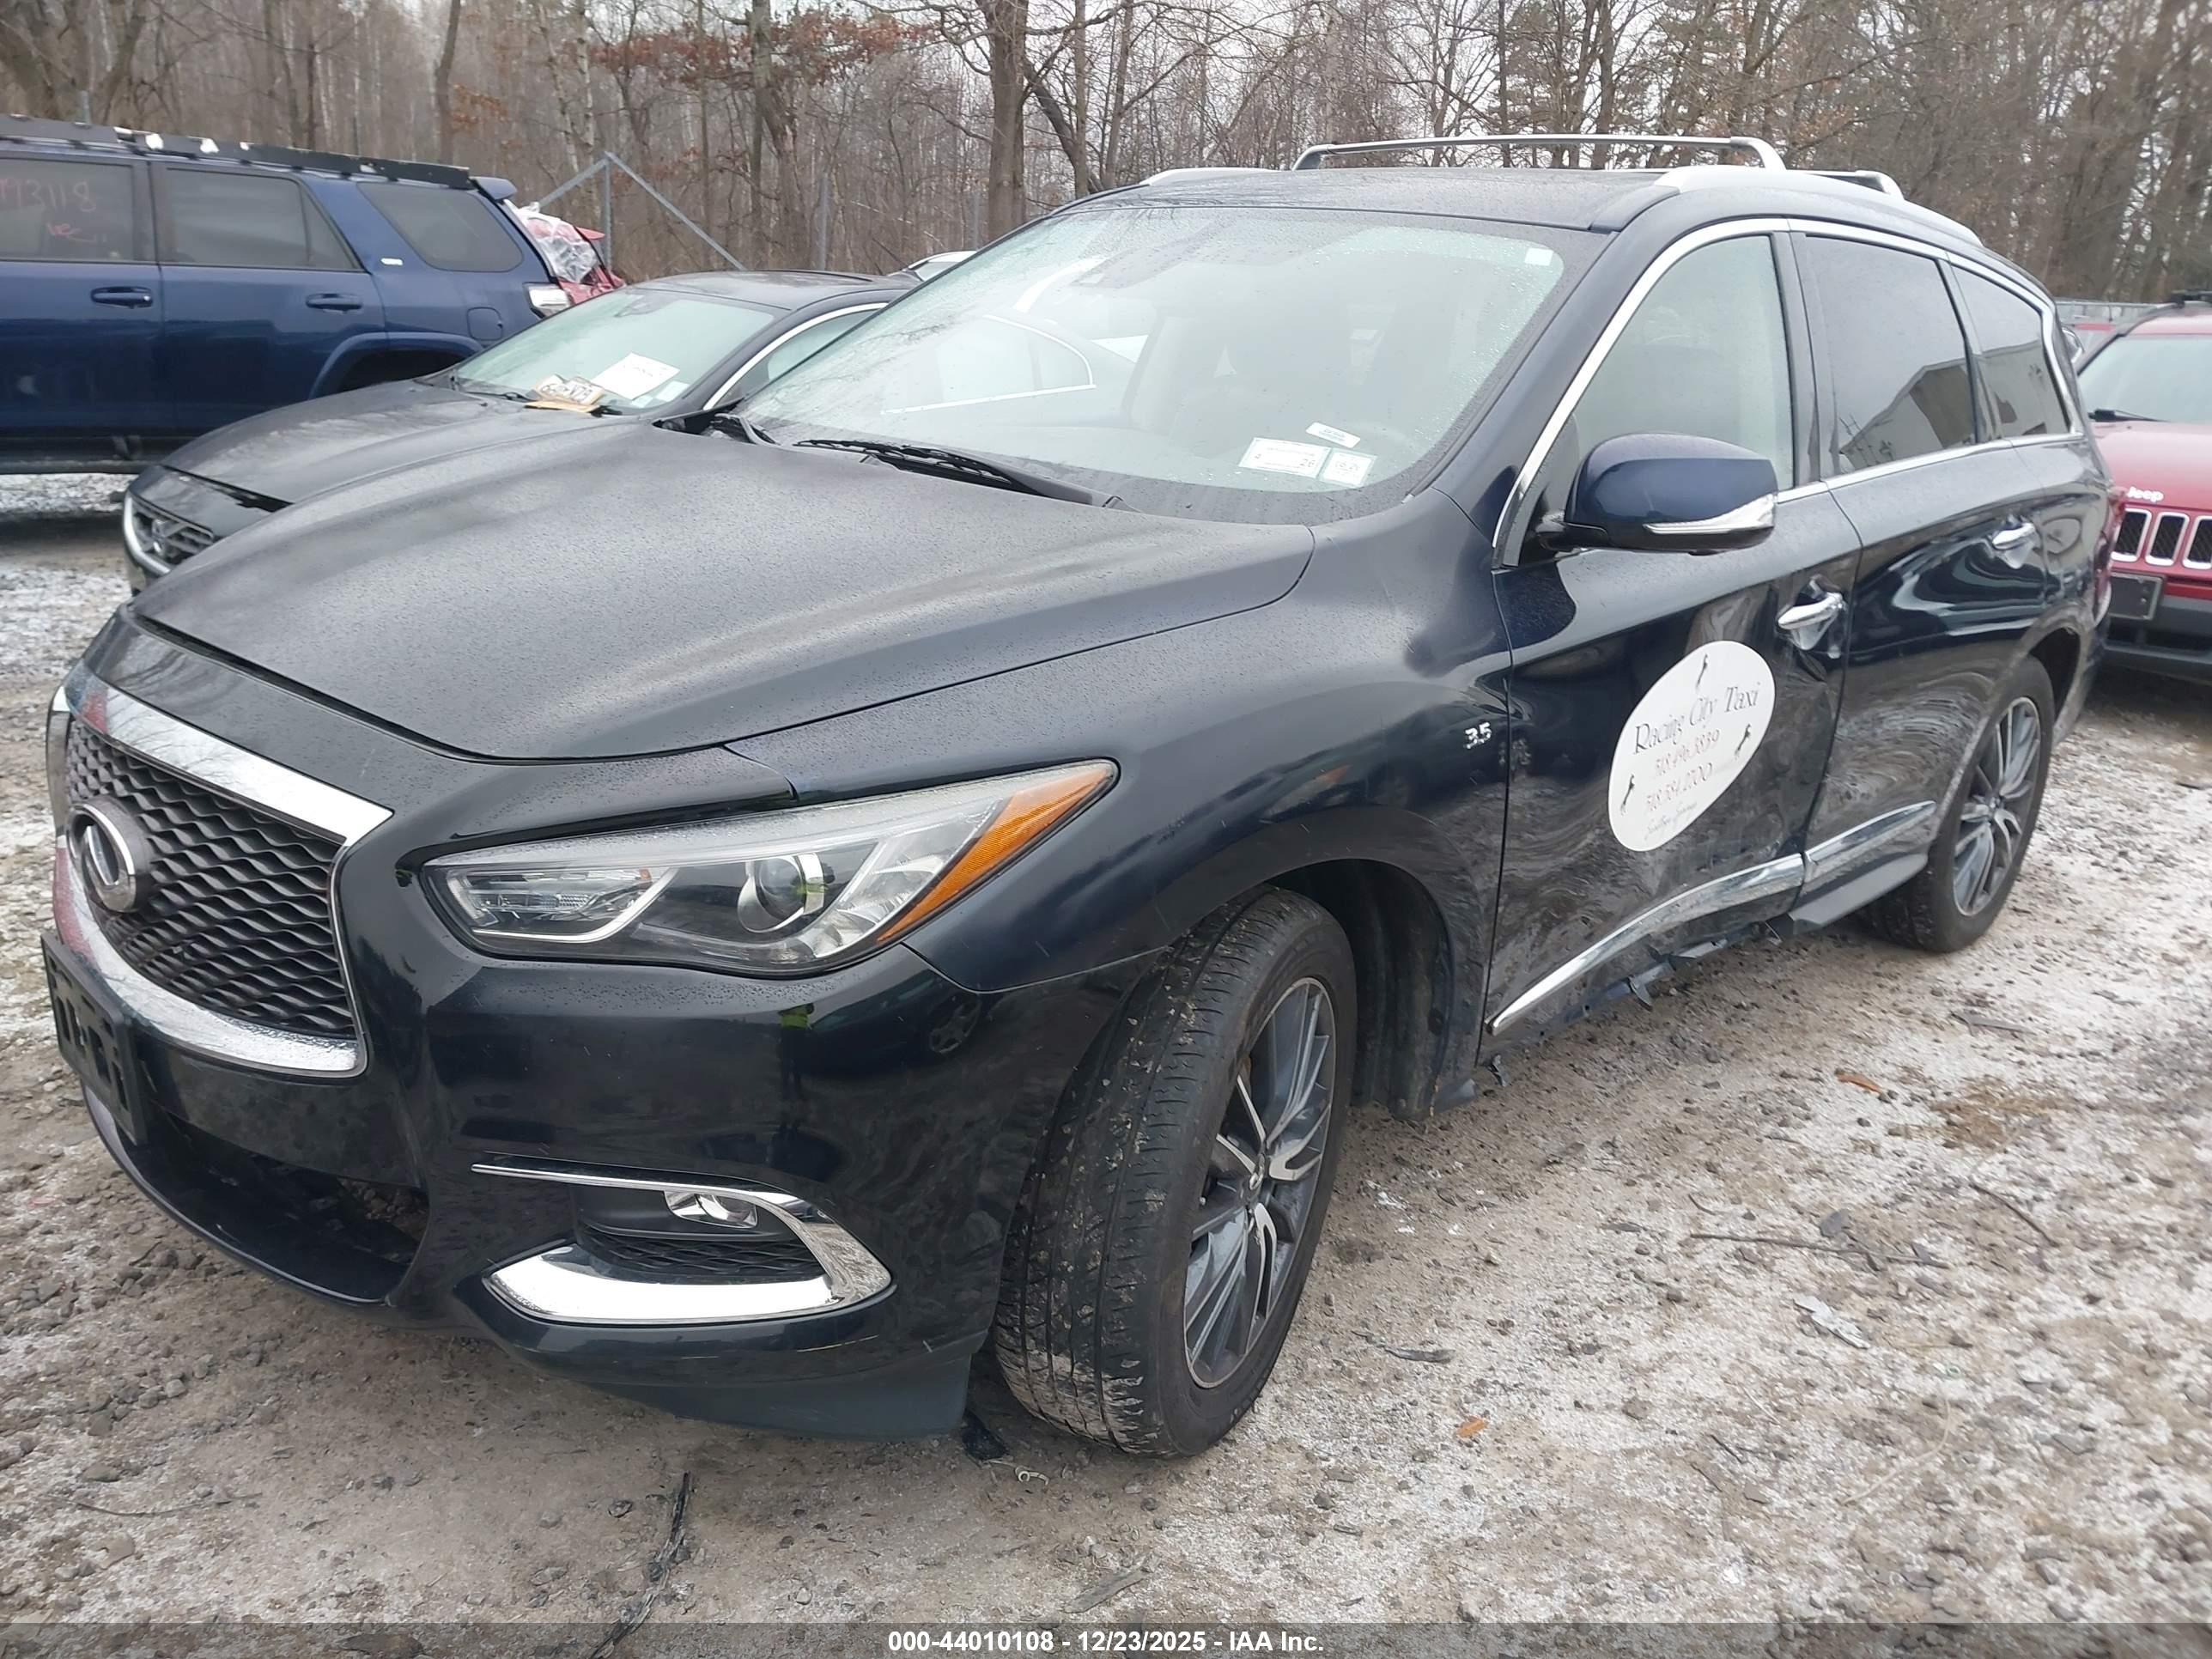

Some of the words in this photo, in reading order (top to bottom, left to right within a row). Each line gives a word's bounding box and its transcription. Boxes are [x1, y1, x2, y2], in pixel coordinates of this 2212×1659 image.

[1635, 715, 1685, 754] Racing
[1689, 697, 1717, 727] City
[1725, 683, 1760, 713] Taxi
